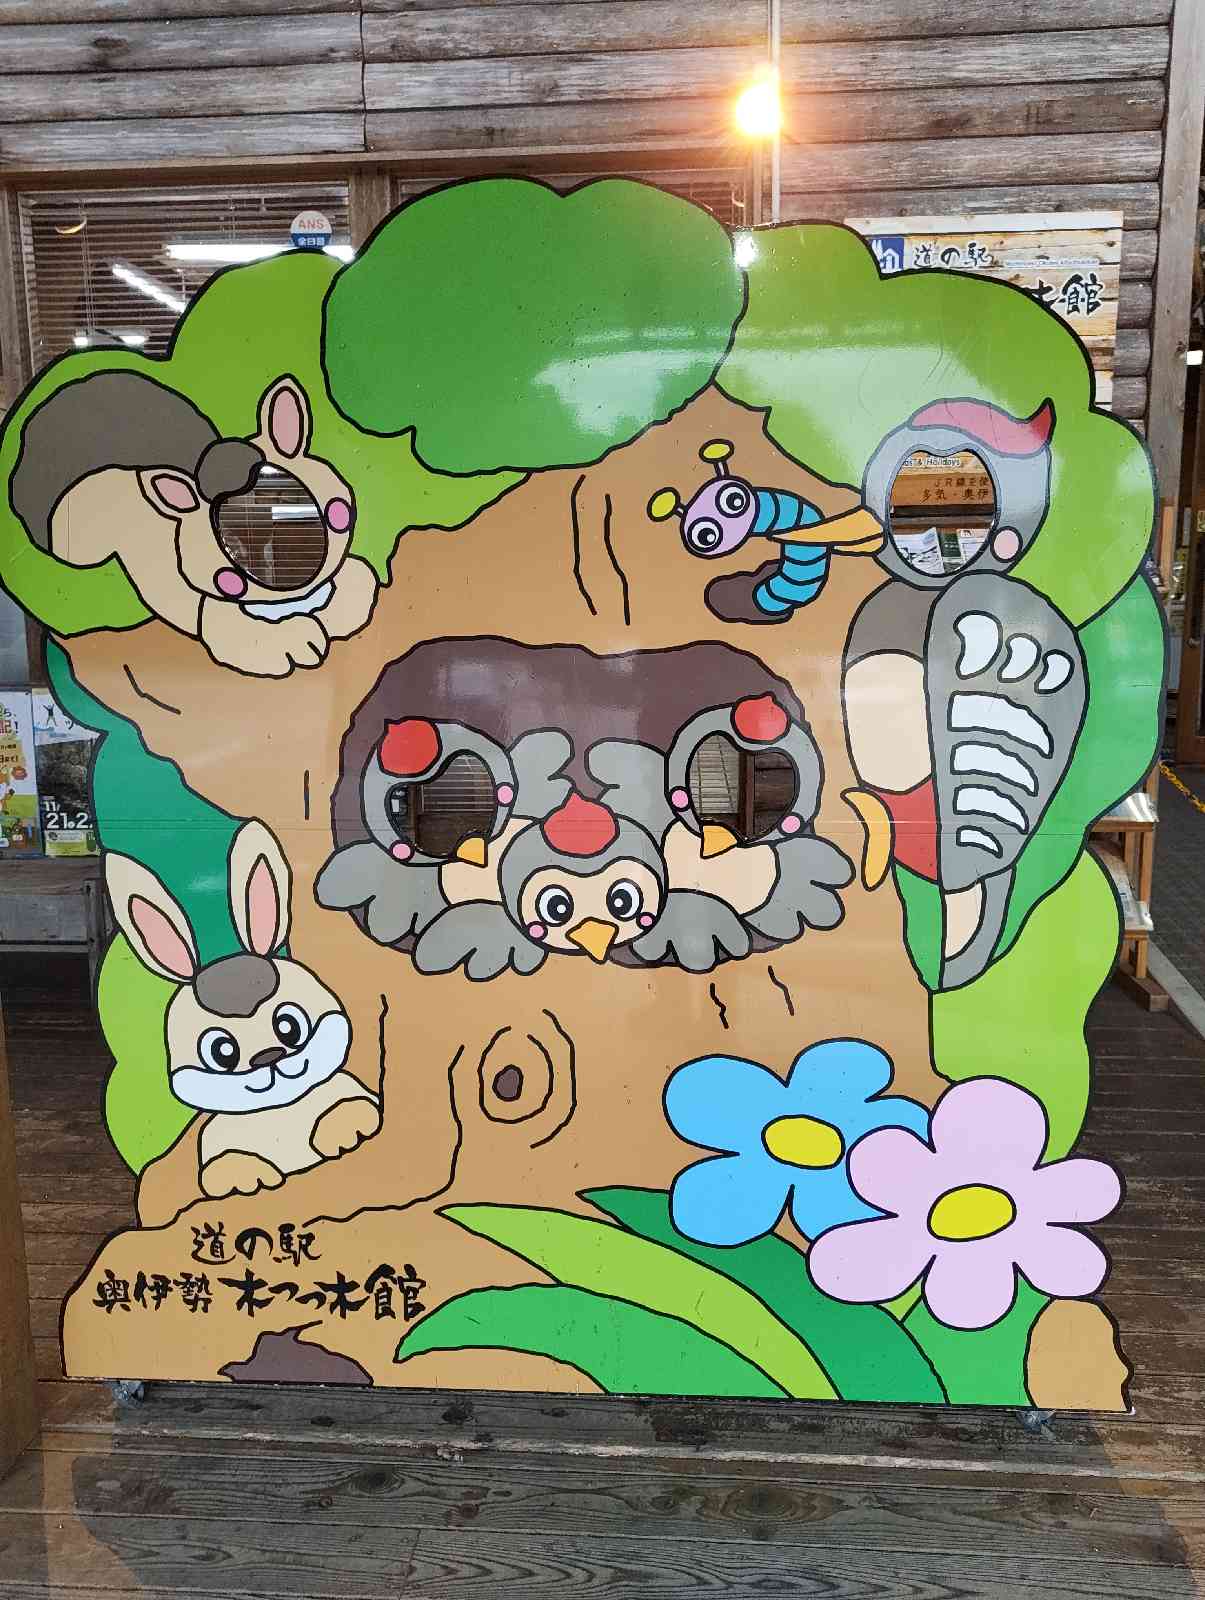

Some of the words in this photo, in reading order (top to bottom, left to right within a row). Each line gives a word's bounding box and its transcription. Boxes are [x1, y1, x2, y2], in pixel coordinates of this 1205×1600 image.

[299, 220, 324, 229] ANS
[914, 242, 992, 267] 道の駅
[926, 457, 960, 468] Holidays
[190, 1221, 322, 1267] 道の駅
